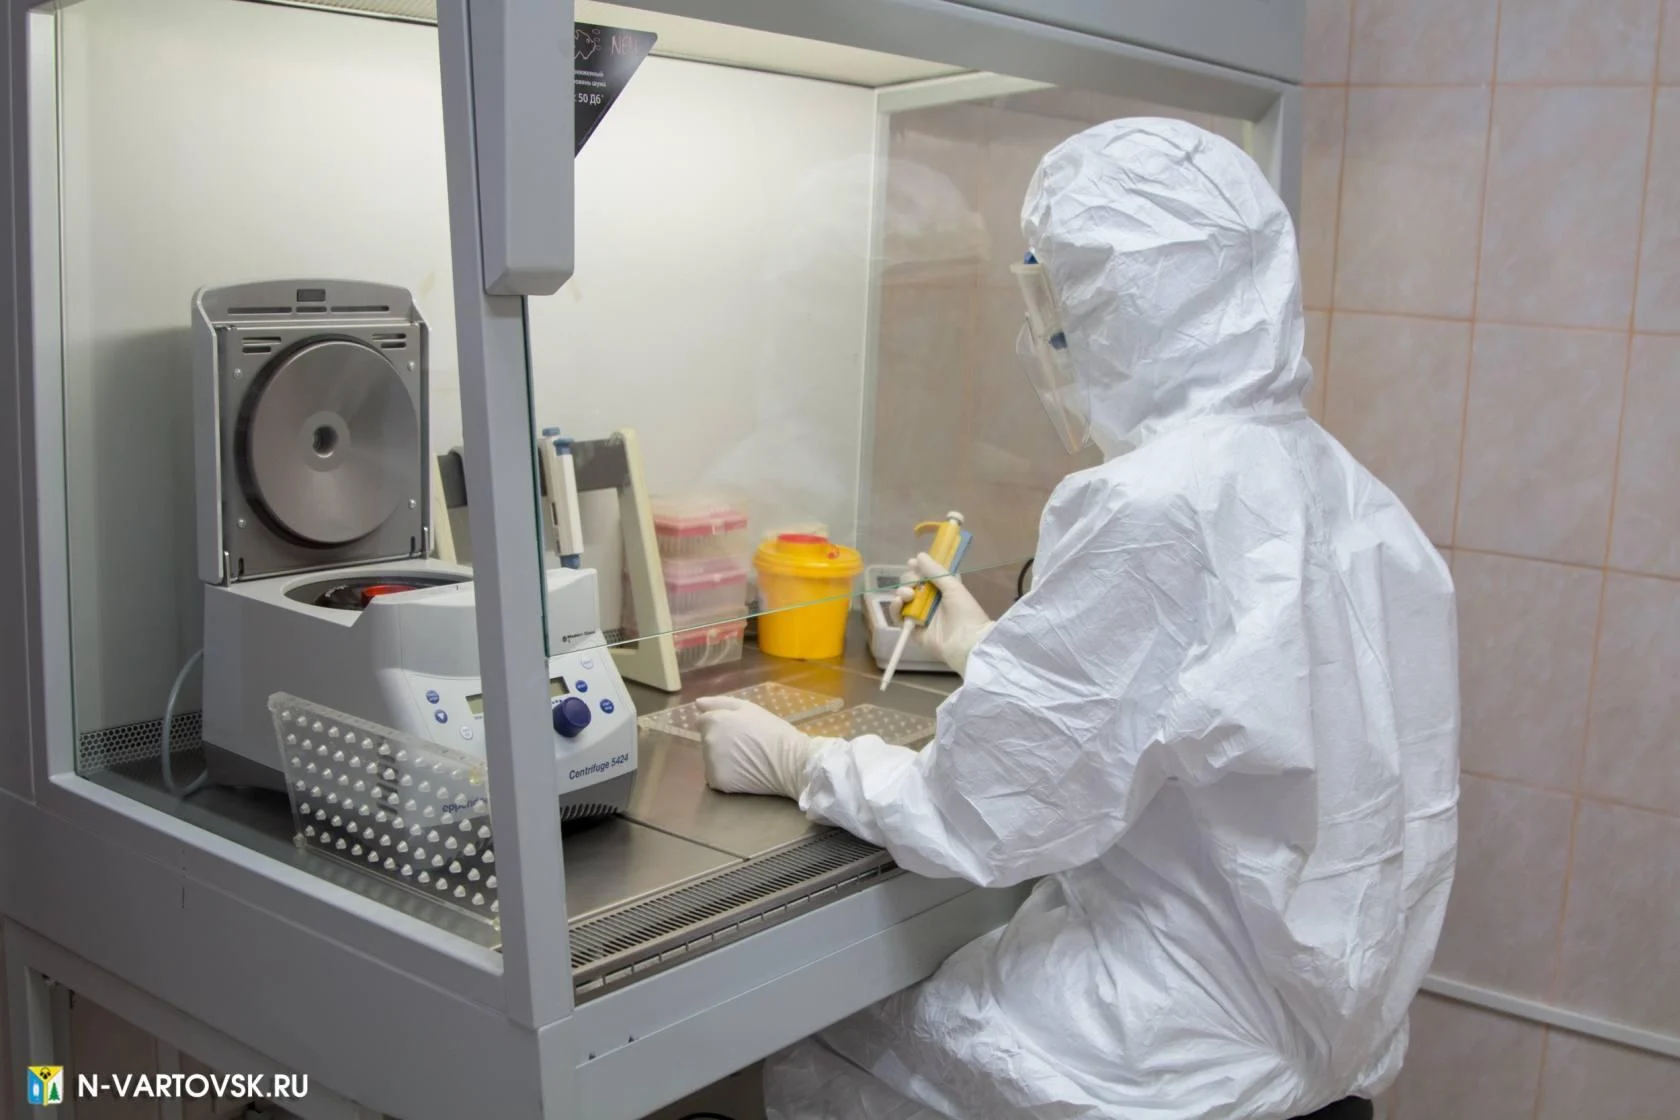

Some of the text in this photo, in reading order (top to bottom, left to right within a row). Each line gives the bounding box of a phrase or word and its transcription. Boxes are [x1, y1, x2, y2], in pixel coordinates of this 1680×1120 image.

[578, 93, 588, 103] 50
[569, 753, 629, 780] Centrifuge 5424
